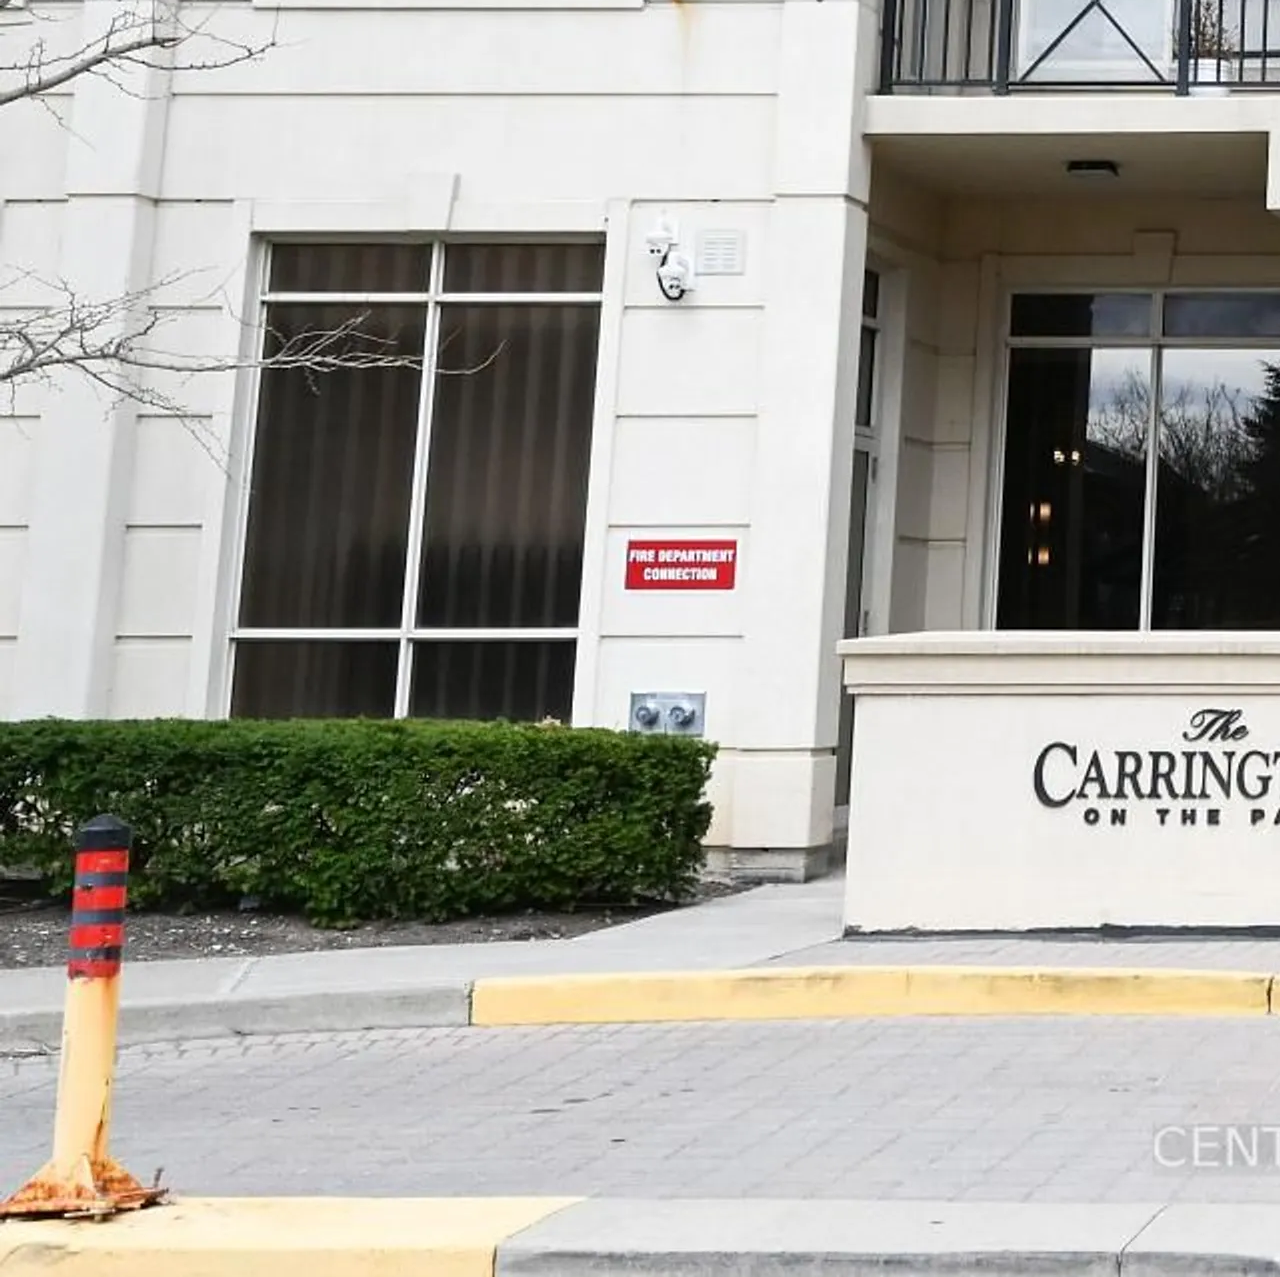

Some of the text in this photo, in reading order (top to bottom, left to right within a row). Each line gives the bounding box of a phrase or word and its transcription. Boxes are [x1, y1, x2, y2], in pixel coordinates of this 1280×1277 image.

[628, 548, 735, 563] FIRE DEPARTMENT
[643, 566, 718, 581] CONNECTION
[1182, 707, 1250, 742] The
[1083, 808, 1128, 825] ON
[1156, 808, 1221, 825] THE
